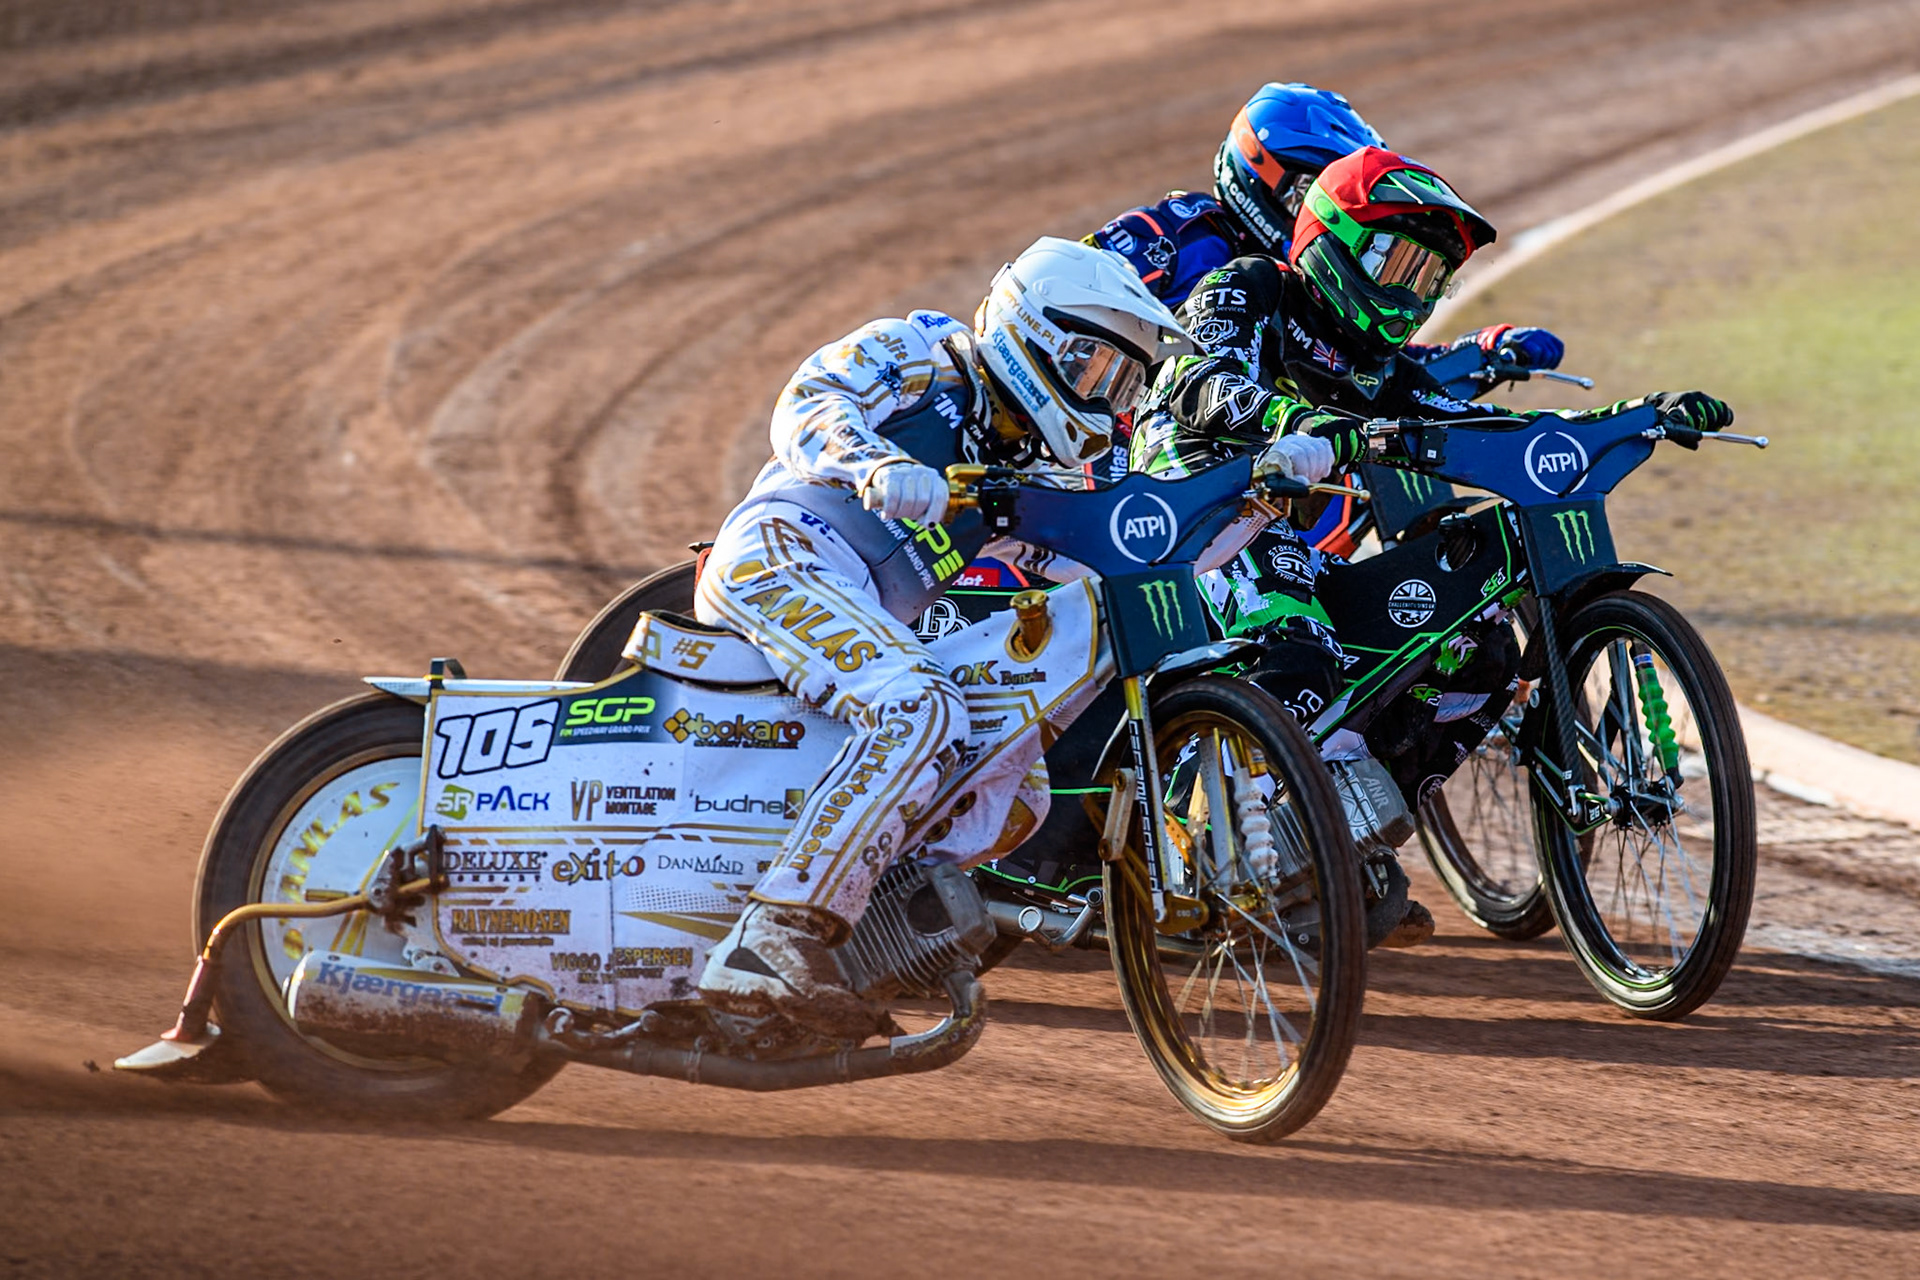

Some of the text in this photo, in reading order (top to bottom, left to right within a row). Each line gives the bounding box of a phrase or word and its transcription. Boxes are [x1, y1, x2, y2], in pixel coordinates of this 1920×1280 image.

[1229, 183, 1281, 243] cellfast
[1200, 287, 1247, 309] FTS
[1215, 305, 1247, 313] Services
[1288, 317, 1313, 350] FIM
[991, 326, 1051, 408] Kjærgaard
[1355, 373, 1379, 386] GP
[1537, 452, 1578, 474] ATPI
[1123, 515, 1166, 541] ATPI
[903, 540, 924, 573] GRAND
[919, 568, 936, 591] PRIX
[1276, 556, 1314, 580] STS
[741, 584, 878, 672] ANLAS
[671, 637, 716, 670] #5
[949, 660, 998, 688] OK
[565, 696, 656, 726] SGP
[435, 699, 561, 779] 105
[634, 724, 651, 733] PRIX
[693, 712, 806, 742] bokaro
[476, 785, 551, 811] PACK
[571, 779, 676, 821] VP VENTILATION
[1362, 776, 1390, 810] ANR
[605, 801, 658, 815] MONTAGE
[1589, 805, 1600, 821] 26
[441, 851, 542, 871] DELUXE
[451, 909, 571, 935] RAVNEMOSEN
[549, 951, 602, 972] VIGGO
